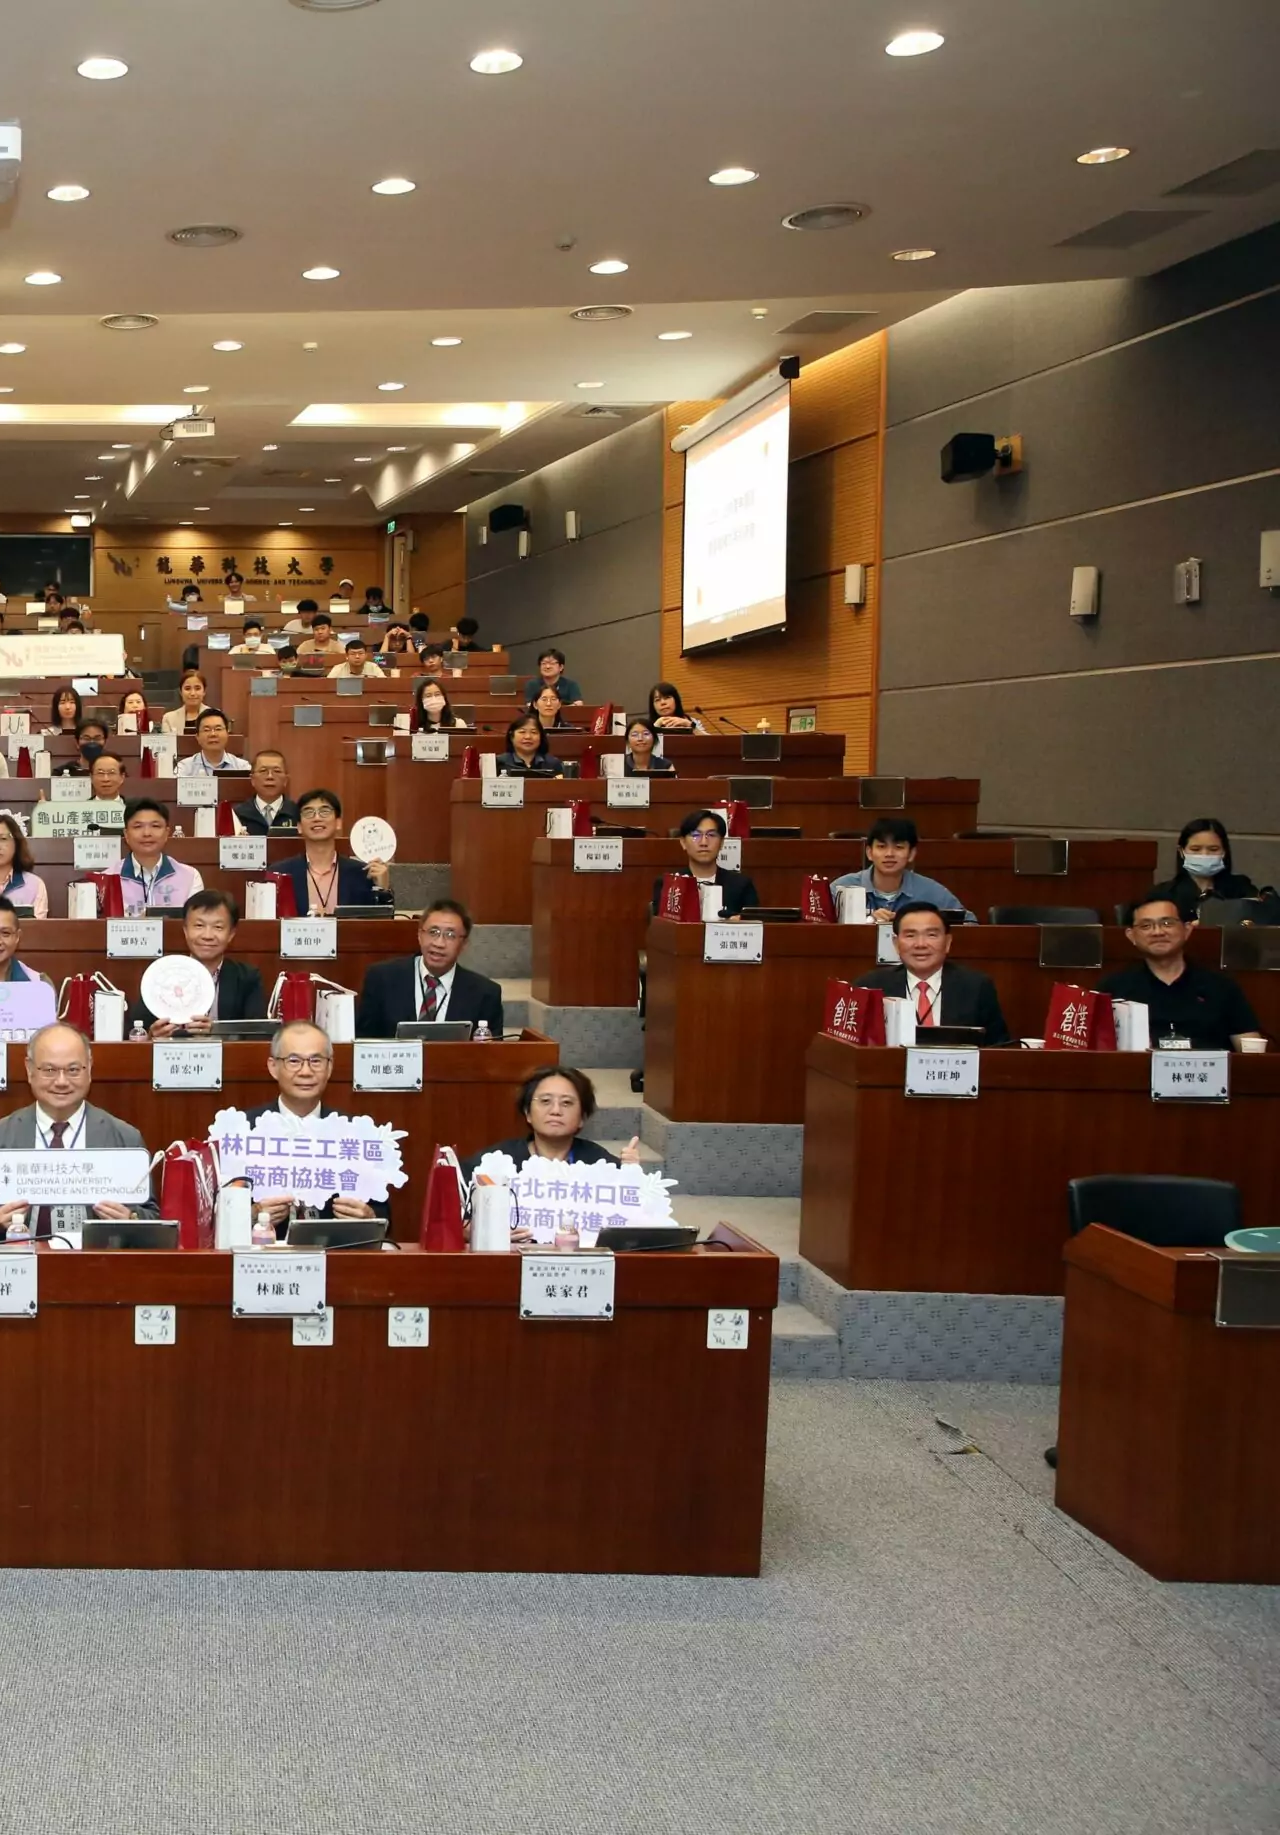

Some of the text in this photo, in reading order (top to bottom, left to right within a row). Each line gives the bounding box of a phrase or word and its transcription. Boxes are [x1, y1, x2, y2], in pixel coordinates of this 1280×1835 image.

[157, 555, 335, 577] 龍華科技大學
[37, 811, 125, 826] 龜山產業園區
[221, 1132, 384, 1162] 林口工三工業區
[16, 1162, 95, 1175] 龍華科技大學
[16, 1176, 113, 1186] LUNGHWA UNIVERSITY
[244, 1165, 360, 1192] 廠商協進會
[16, 1186, 148, 1196] OF SCIENCE AND TECHNOLGY
[545, 1284, 589, 1298] 葉家君
